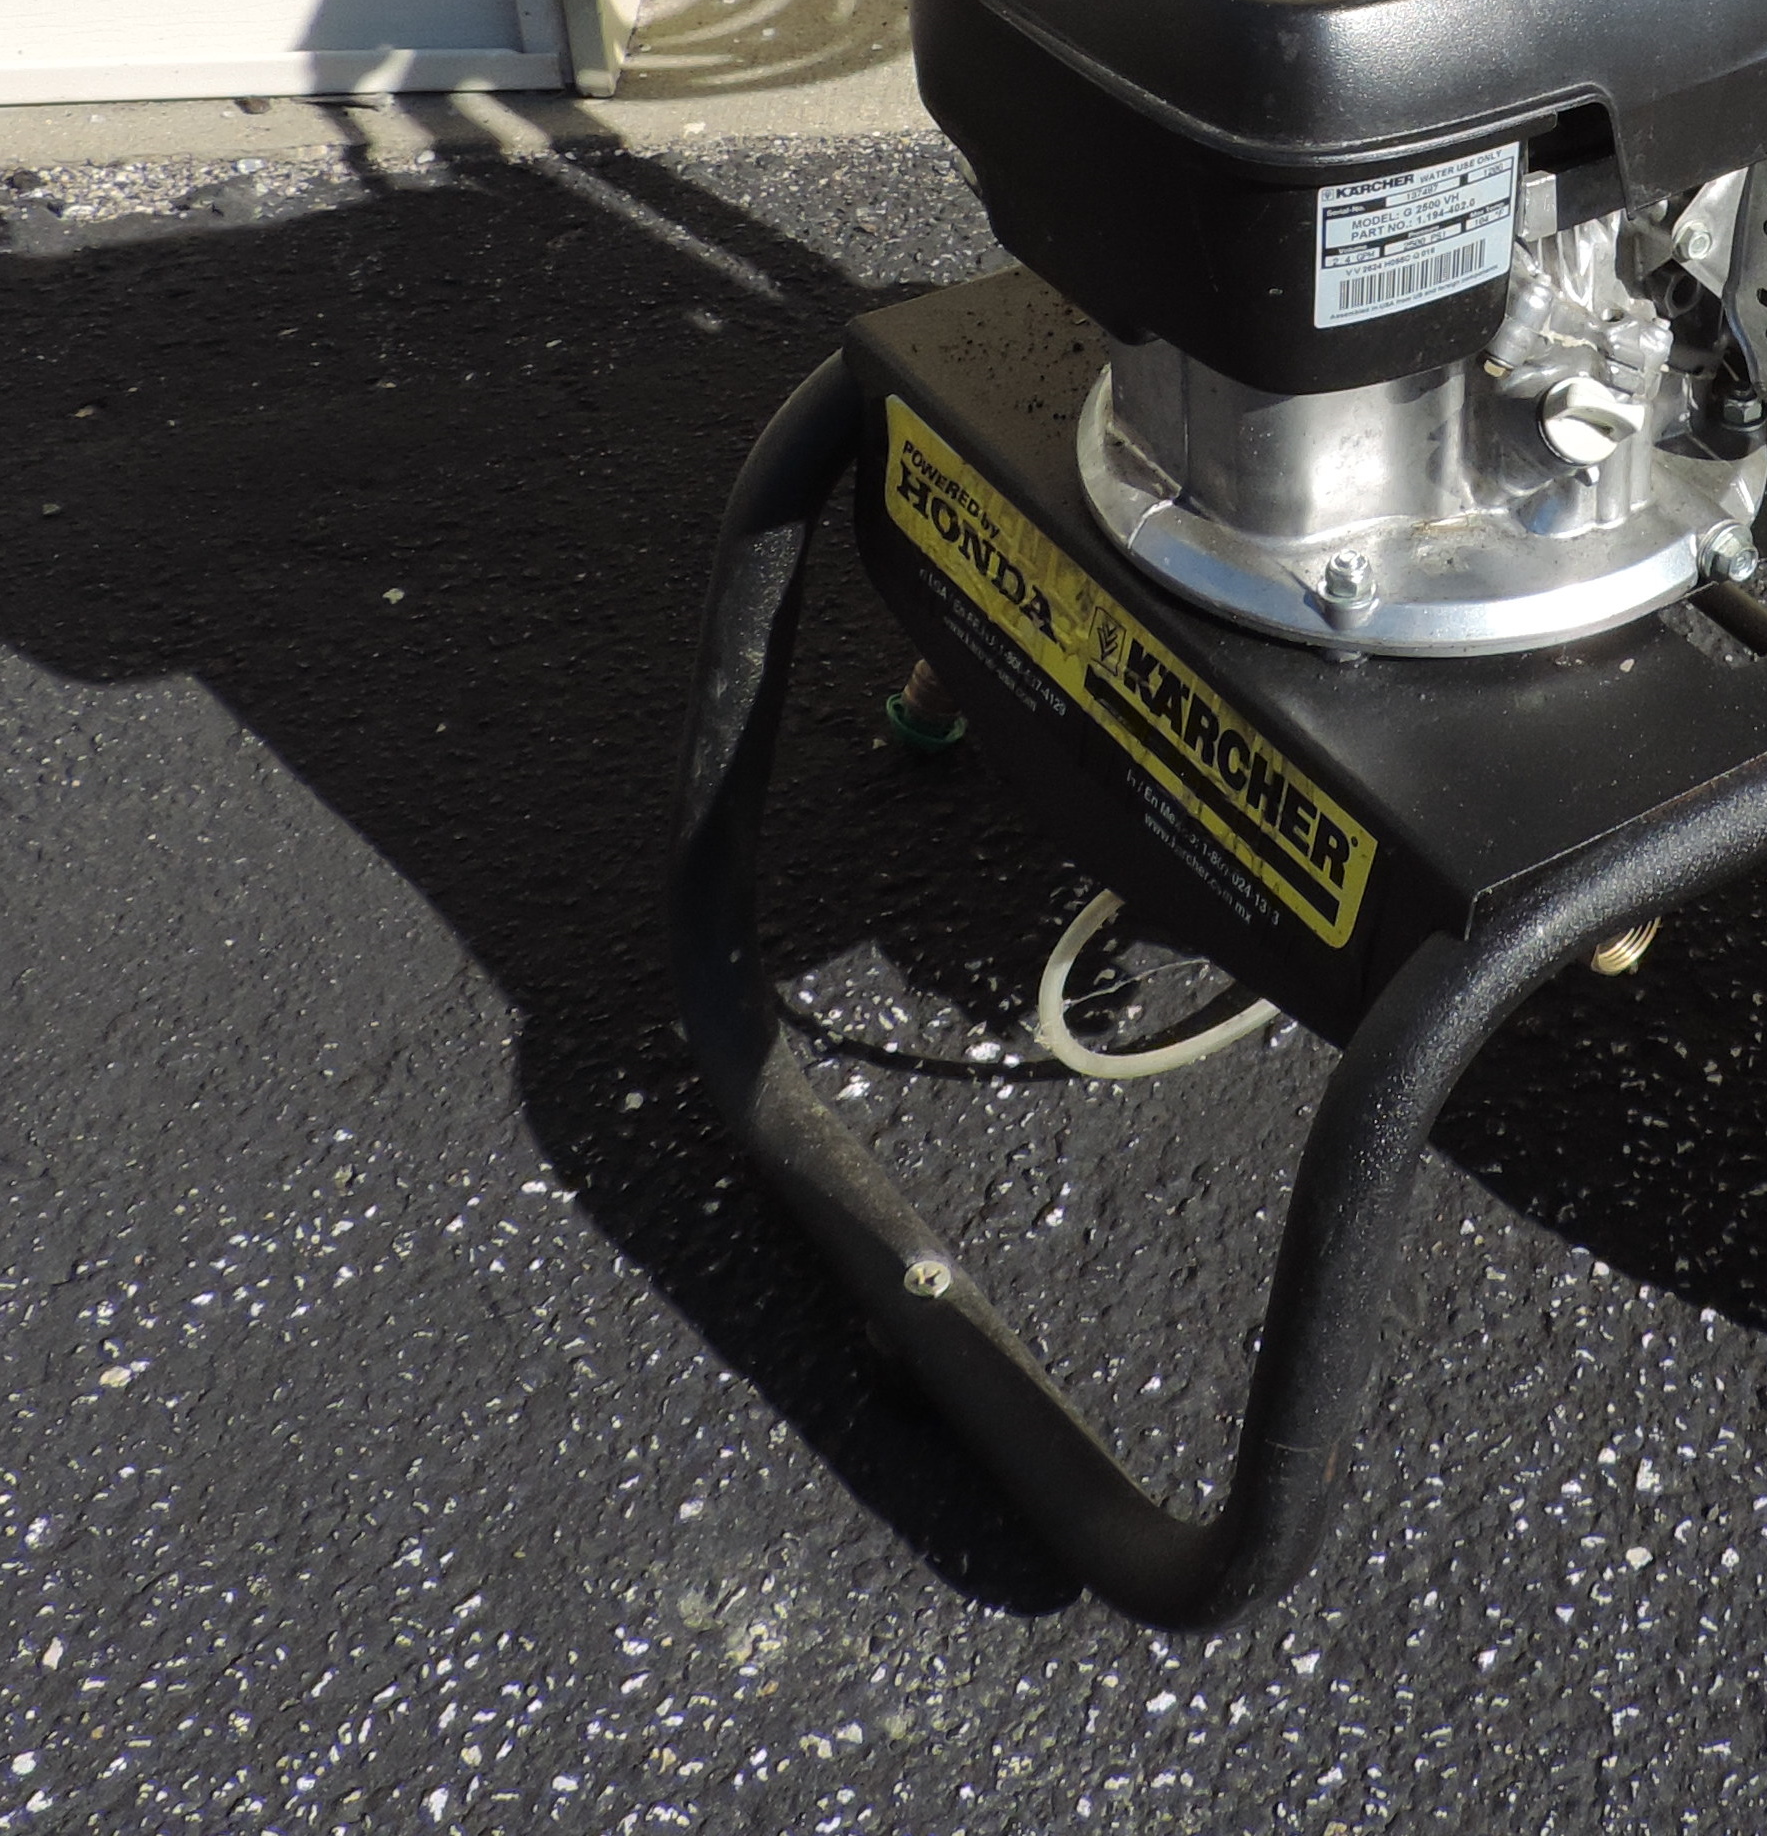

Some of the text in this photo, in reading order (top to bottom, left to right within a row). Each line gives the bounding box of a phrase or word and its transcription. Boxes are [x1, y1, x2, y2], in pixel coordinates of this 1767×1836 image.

[1336, 149, 1502, 199] KÄRCHER WATER USE ONLY
[1352, 211, 1400, 230] MODEL:
[1416, 199, 1440, 214] 2500
[1444, 192, 1459, 205] VH
[1351, 226, 1385, 241] PART
[902, 440, 1001, 540] POWERED by
[896, 463, 1059, 646] HONDA
[1122, 638, 1346, 890] KÄRCHER
